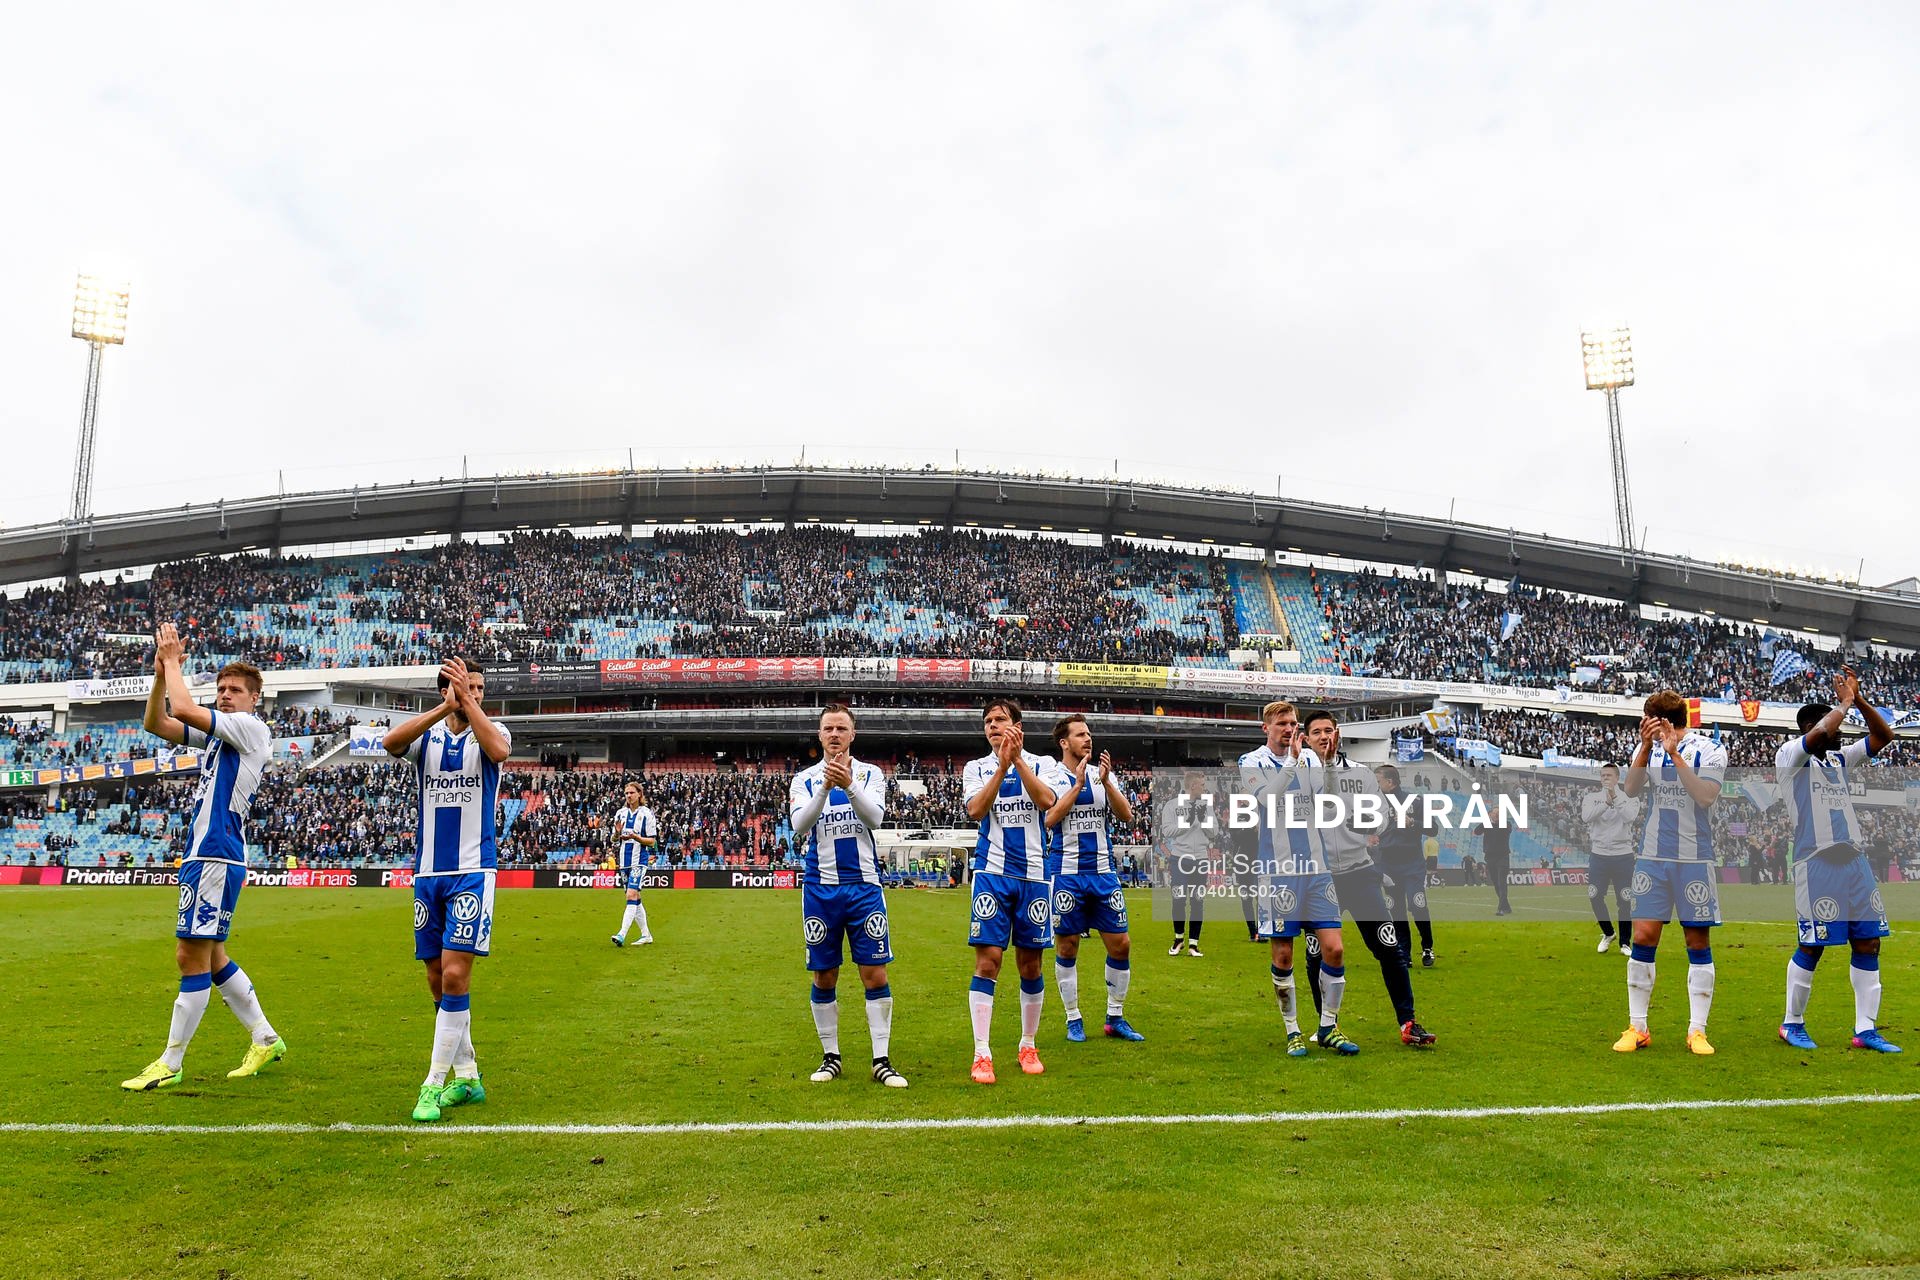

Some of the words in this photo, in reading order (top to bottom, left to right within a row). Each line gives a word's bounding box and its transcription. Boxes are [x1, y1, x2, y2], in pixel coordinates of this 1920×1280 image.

[607, 660, 637, 672] Estrella
[642, 660, 672, 671] Estrella
[682, 660, 712, 671] Estrella
[716, 659, 746, 671] Estrella
[1066, 663, 1079, 671] Dit
[1094, 664, 1111, 673] vill,
[1131, 665, 1142, 673] du
[1144, 666, 1161, 674] vill.
[107, 678, 144, 688] SEKTION
[90, 685, 150, 697] KUNGSBACKA
[1483, 685, 1508, 695] higab
[1515, 687, 1541, 698] higab
[1592, 693, 1618, 704] higab
[425, 774, 481, 790] Prioritet
[1340, 779, 1363, 794] ORG
[429, 789, 472, 803] Finans
[992, 799, 1037, 813] riorite
[817, 807, 857, 825] Priorit
[824, 822, 863, 837] Finans
[1069, 819, 1102, 831] Finans
[66, 867, 132, 886] Prioritet
[133, 868, 179, 885] Finans
[245, 870, 309, 887] Prioritet
[310, 872, 358, 886] Finans
[558, 872, 621, 887] Prioritet
[732, 873, 794, 888] Prioritet
[1506, 870, 1551, 884] rioritet
[1552, 870, 1590, 884] Finans
[1695, 906, 1710, 917] 28
[1118, 913, 1127, 923] 10
[453, 923, 474, 939] 30
[1040, 926, 1046, 937] 7
[878, 940, 885, 953] 3
